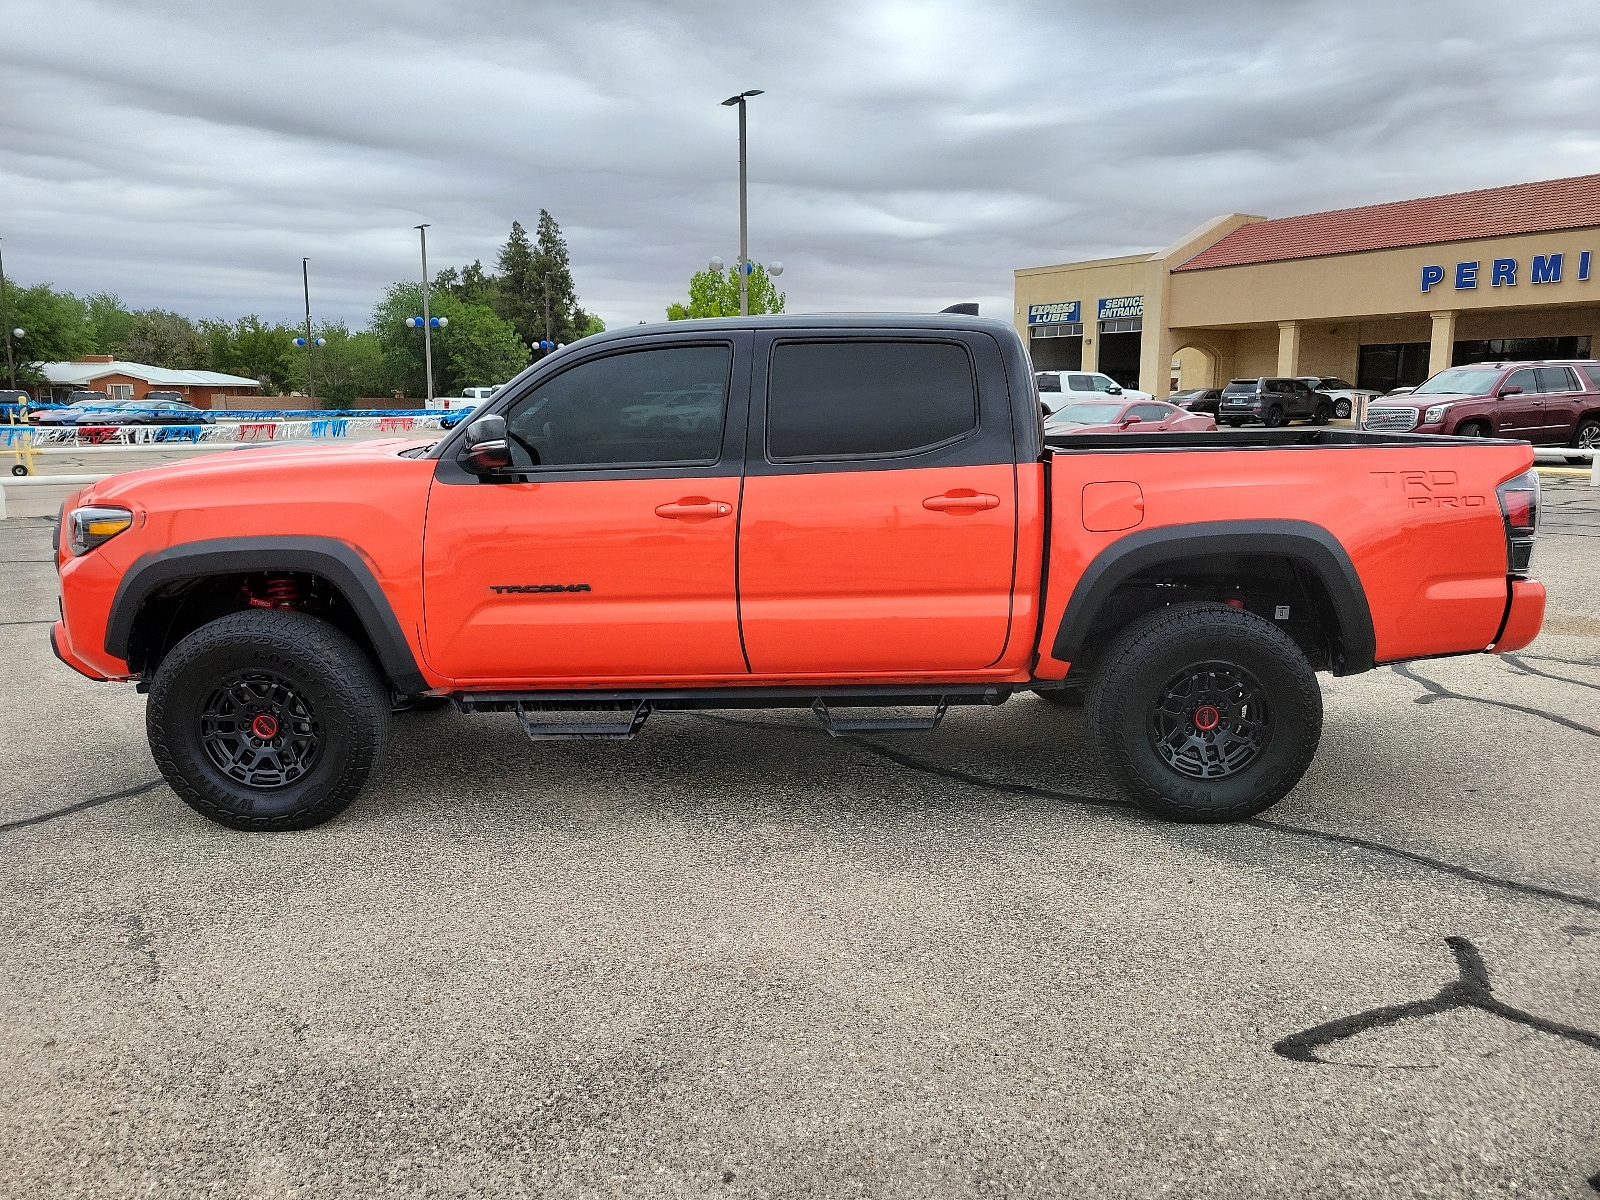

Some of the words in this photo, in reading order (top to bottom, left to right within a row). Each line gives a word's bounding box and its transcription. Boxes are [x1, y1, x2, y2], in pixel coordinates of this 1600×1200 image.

[1031, 302, 1075, 315] EXPRESS
[1100, 306, 1143, 318] ENTRANC
[1036, 313, 1069, 322] LUBE
[1369, 470, 1459, 492] TRD
[1407, 495, 1486, 509] PRO
[490, 584, 591, 594] TACOMA
